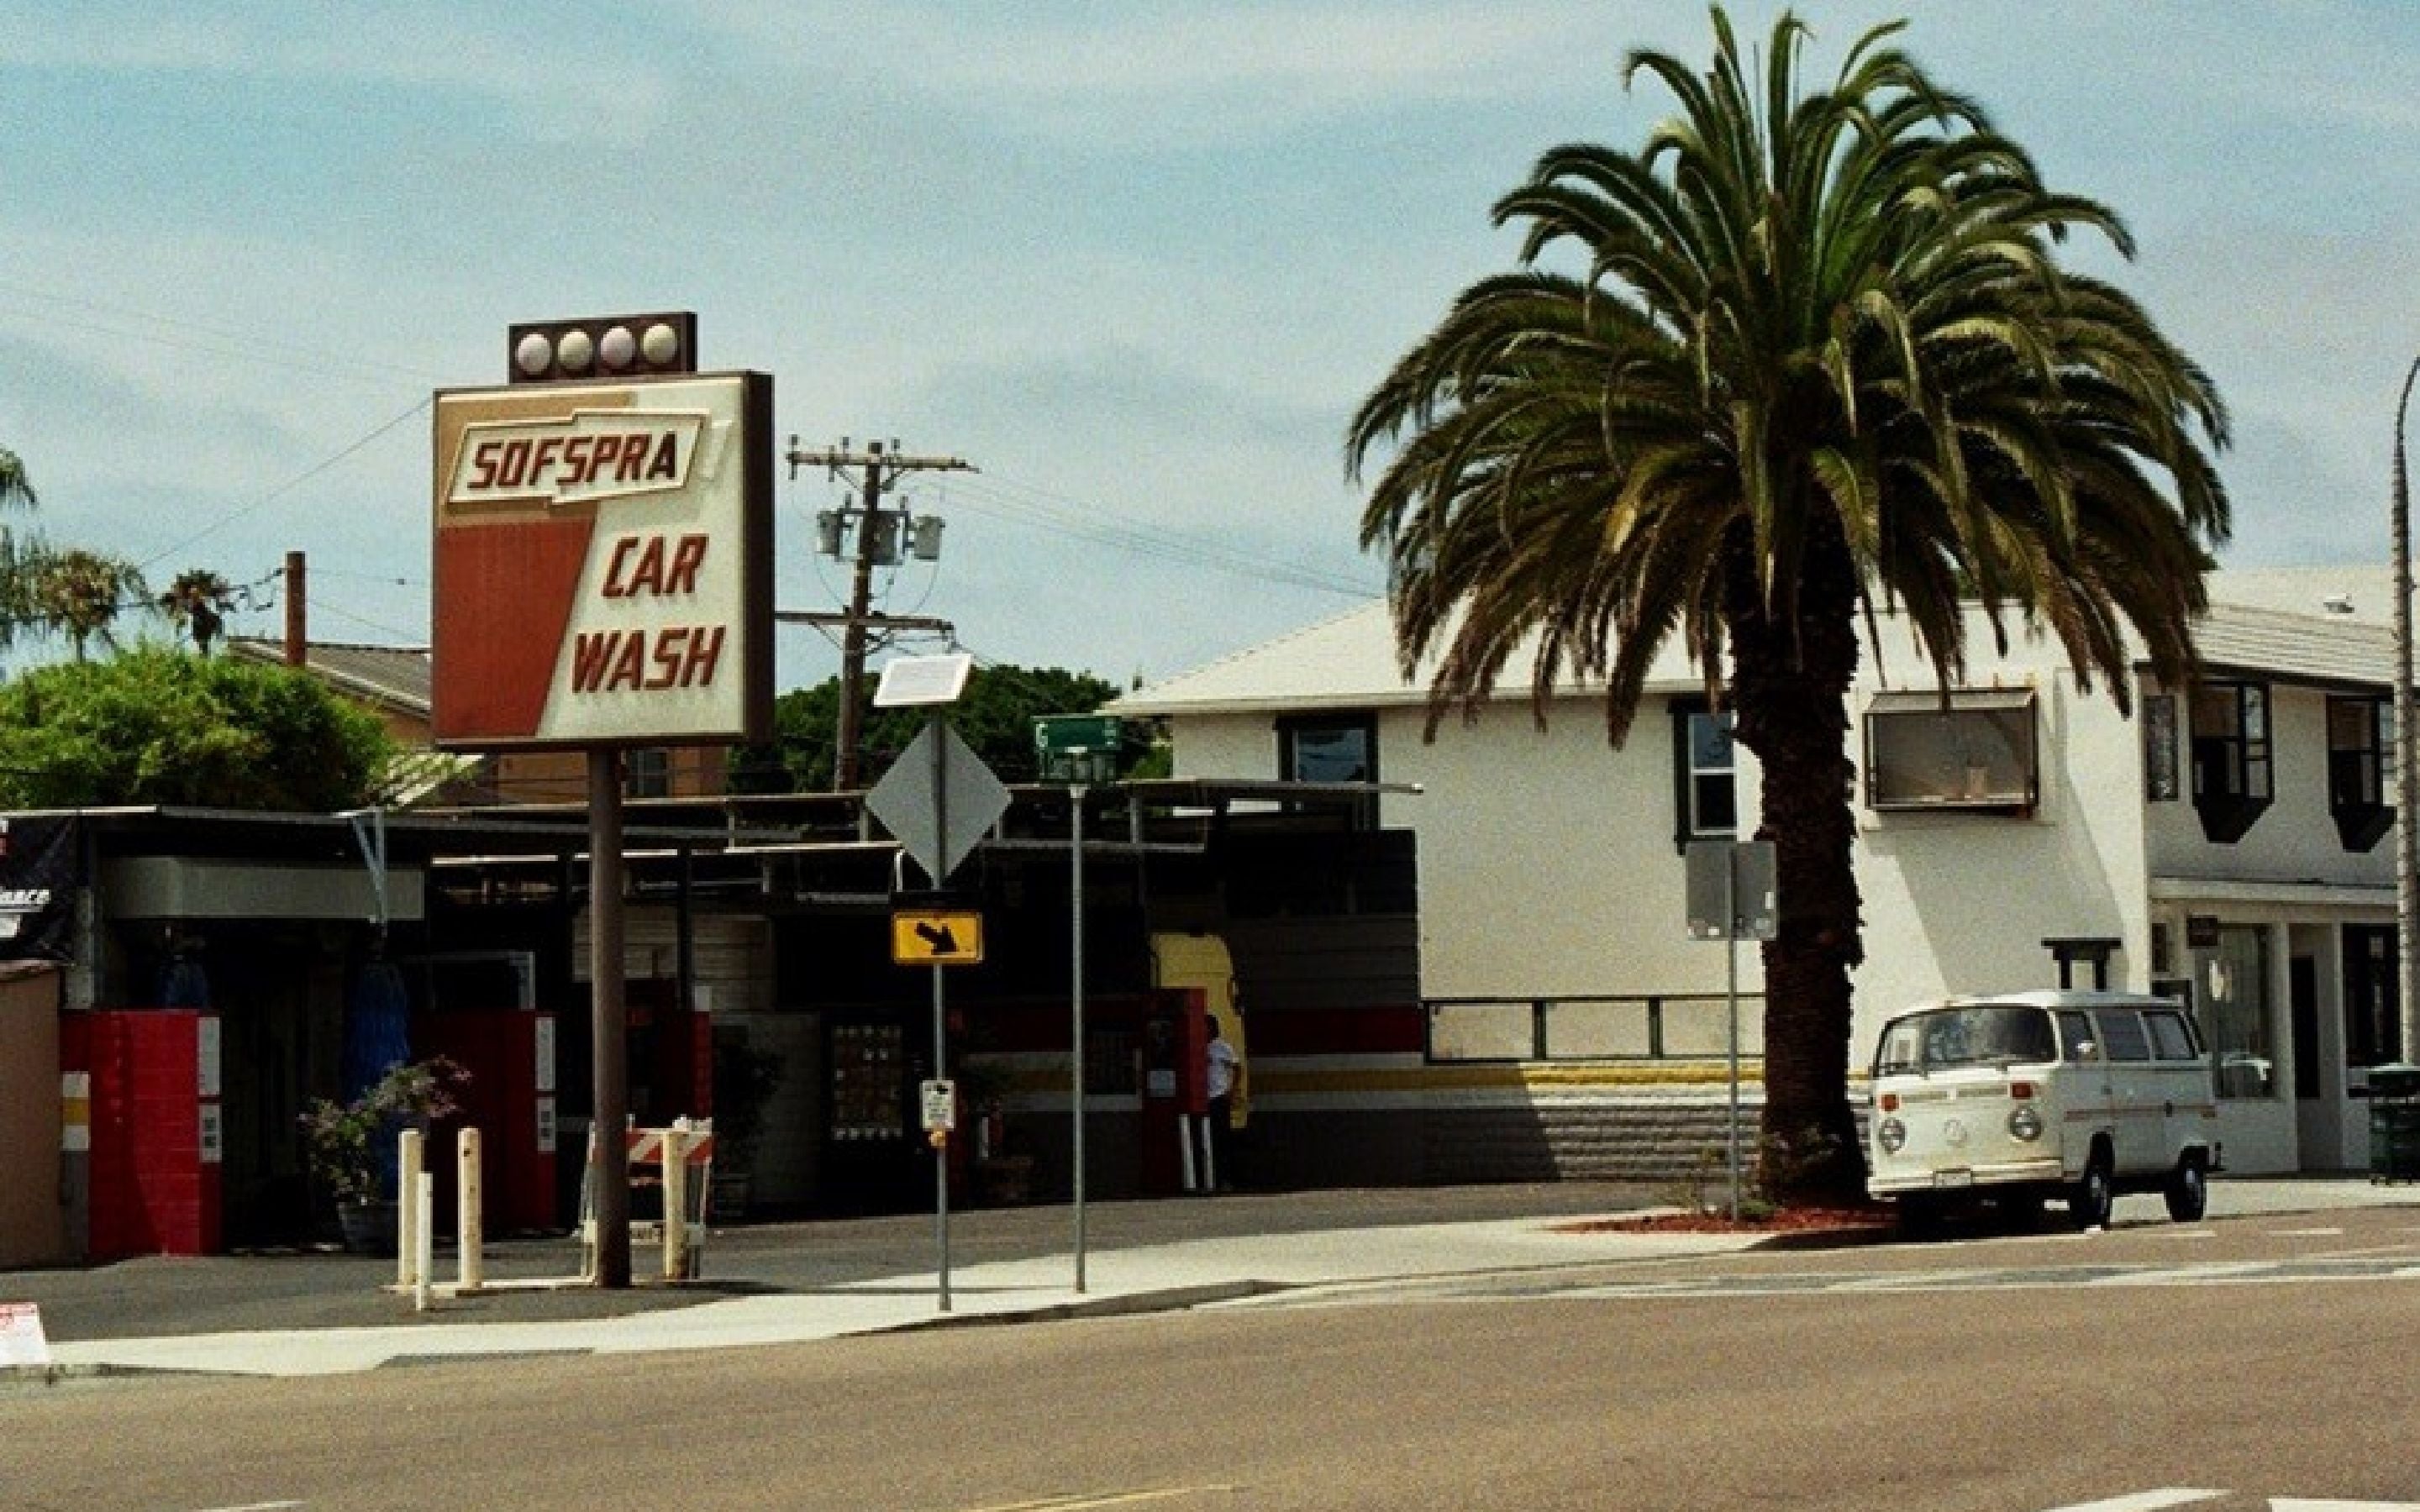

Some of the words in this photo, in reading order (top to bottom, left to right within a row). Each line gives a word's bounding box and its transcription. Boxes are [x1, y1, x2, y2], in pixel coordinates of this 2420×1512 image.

[467, 430, 677, 491] SOFSPRA
[602, 533, 709, 599] CAR
[571, 625, 726, 694] WASH
